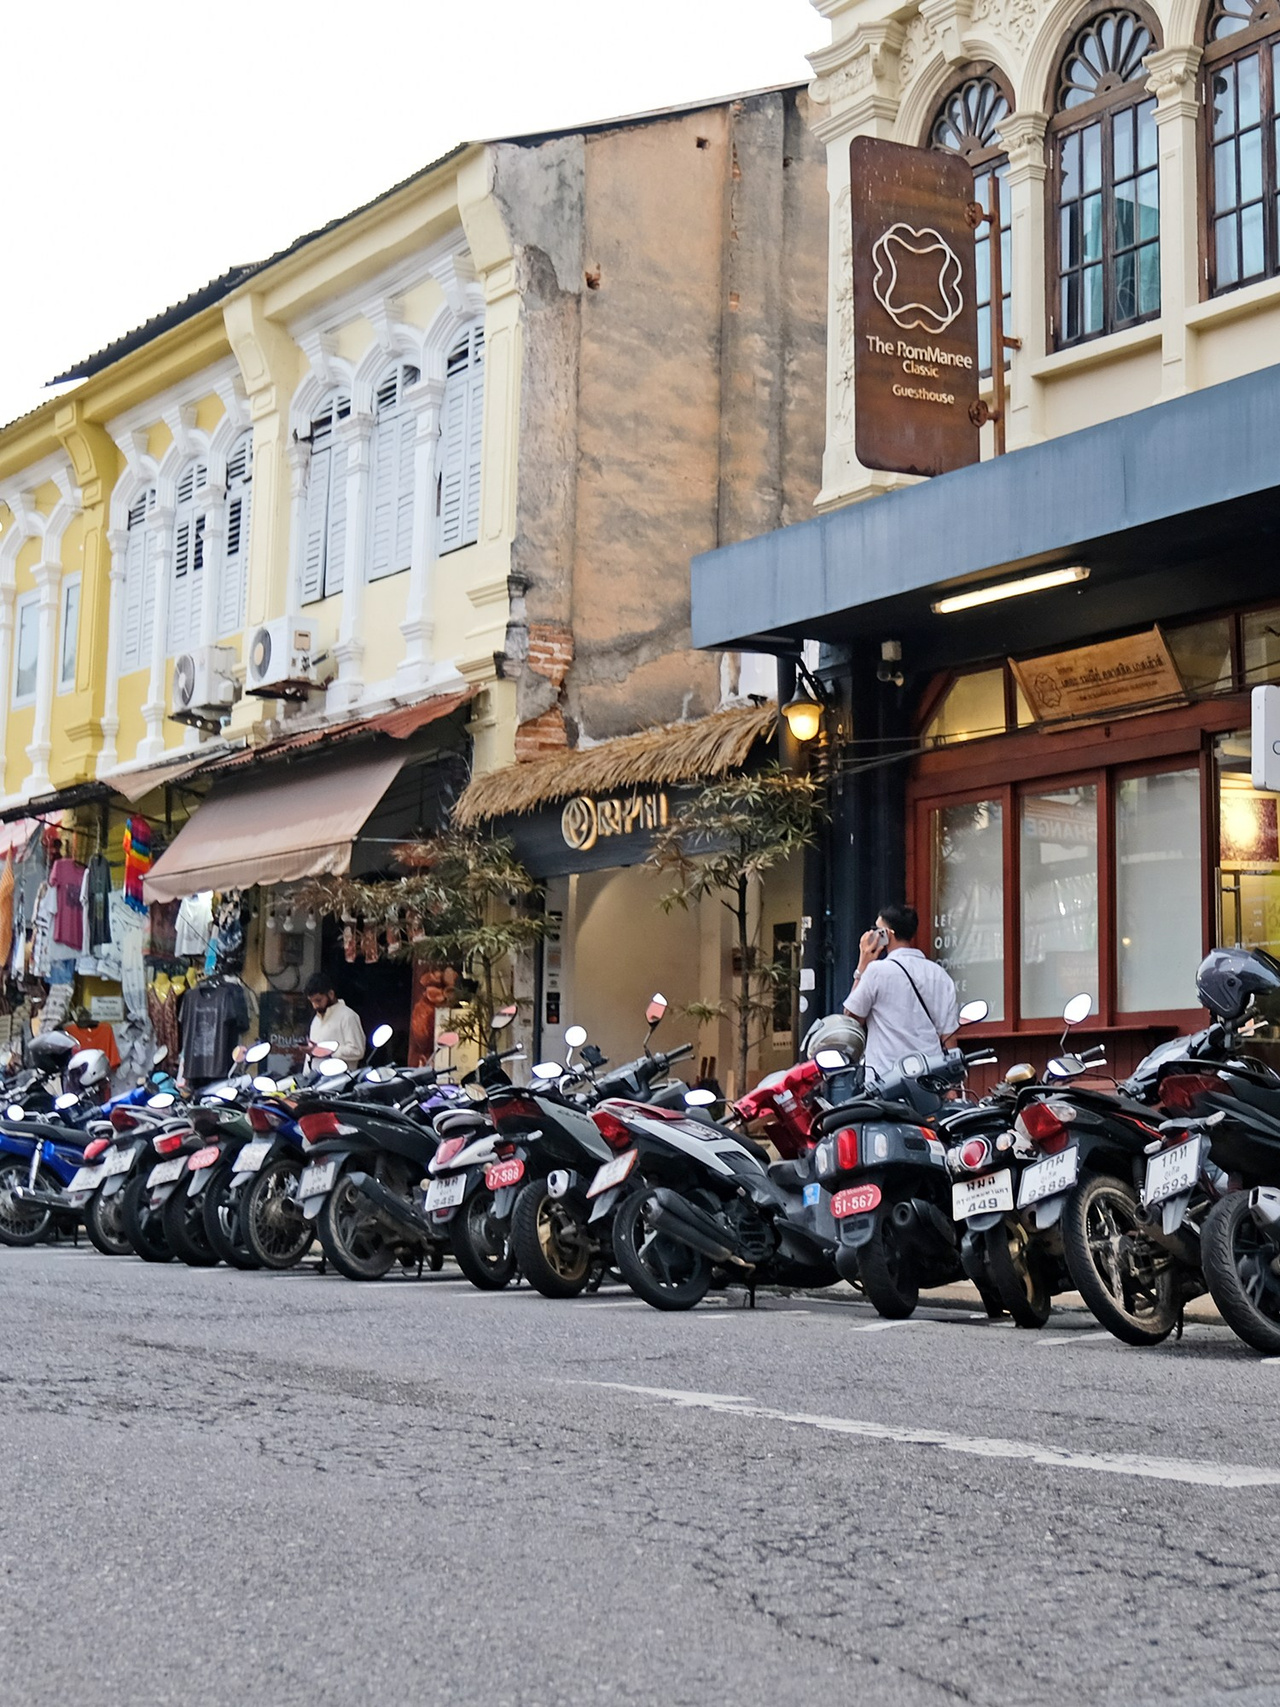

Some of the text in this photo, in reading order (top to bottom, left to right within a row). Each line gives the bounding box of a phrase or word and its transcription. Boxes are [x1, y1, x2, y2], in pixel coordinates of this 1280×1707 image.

[866, 335, 894, 355] The
[902, 360, 939, 378] Classic
[892, 384, 955, 404] Guesthouse
[934, 935, 958, 949] OUR
[1153, 1173, 1188, 1200] 6593
[968, 1197, 998, 1212] 449
